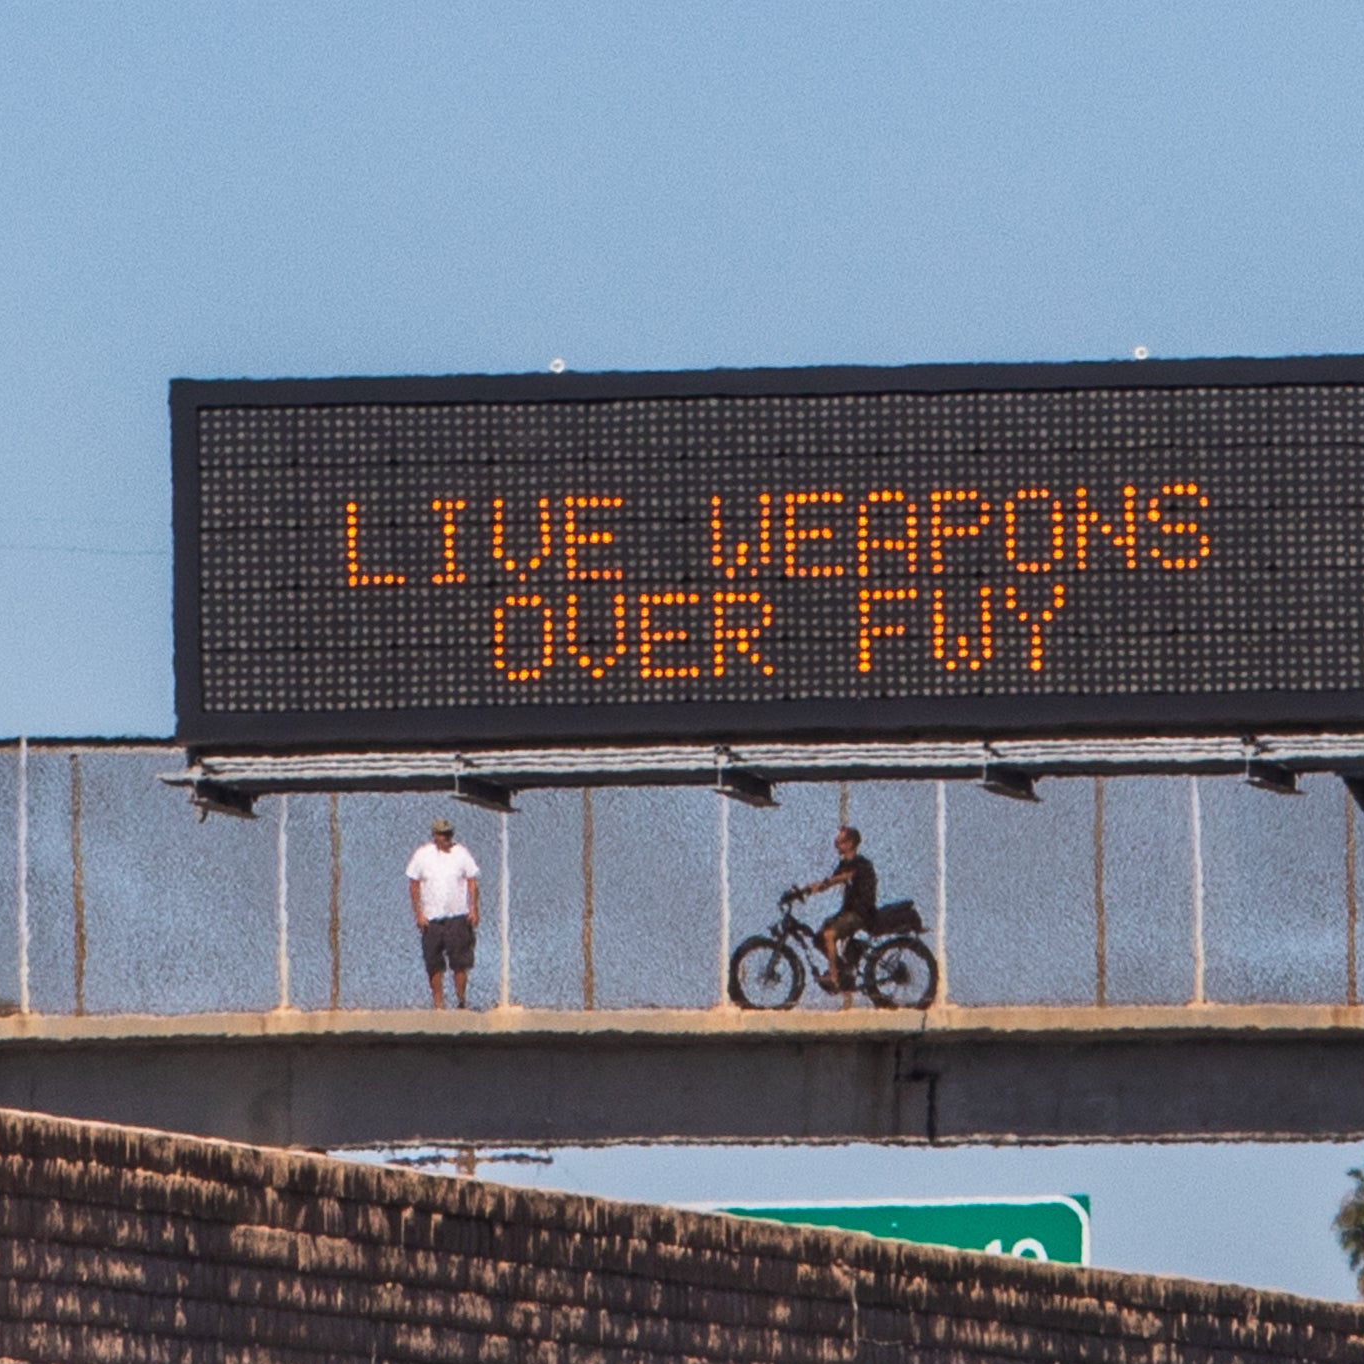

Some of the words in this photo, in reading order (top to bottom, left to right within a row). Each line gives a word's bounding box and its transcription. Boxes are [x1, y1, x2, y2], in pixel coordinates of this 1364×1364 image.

[345, 496, 624, 588] LIVE
[710, 483, 1211, 580] WEAPONS
[493, 592, 775, 681] OVER
[857, 584, 1066, 673] FWY
